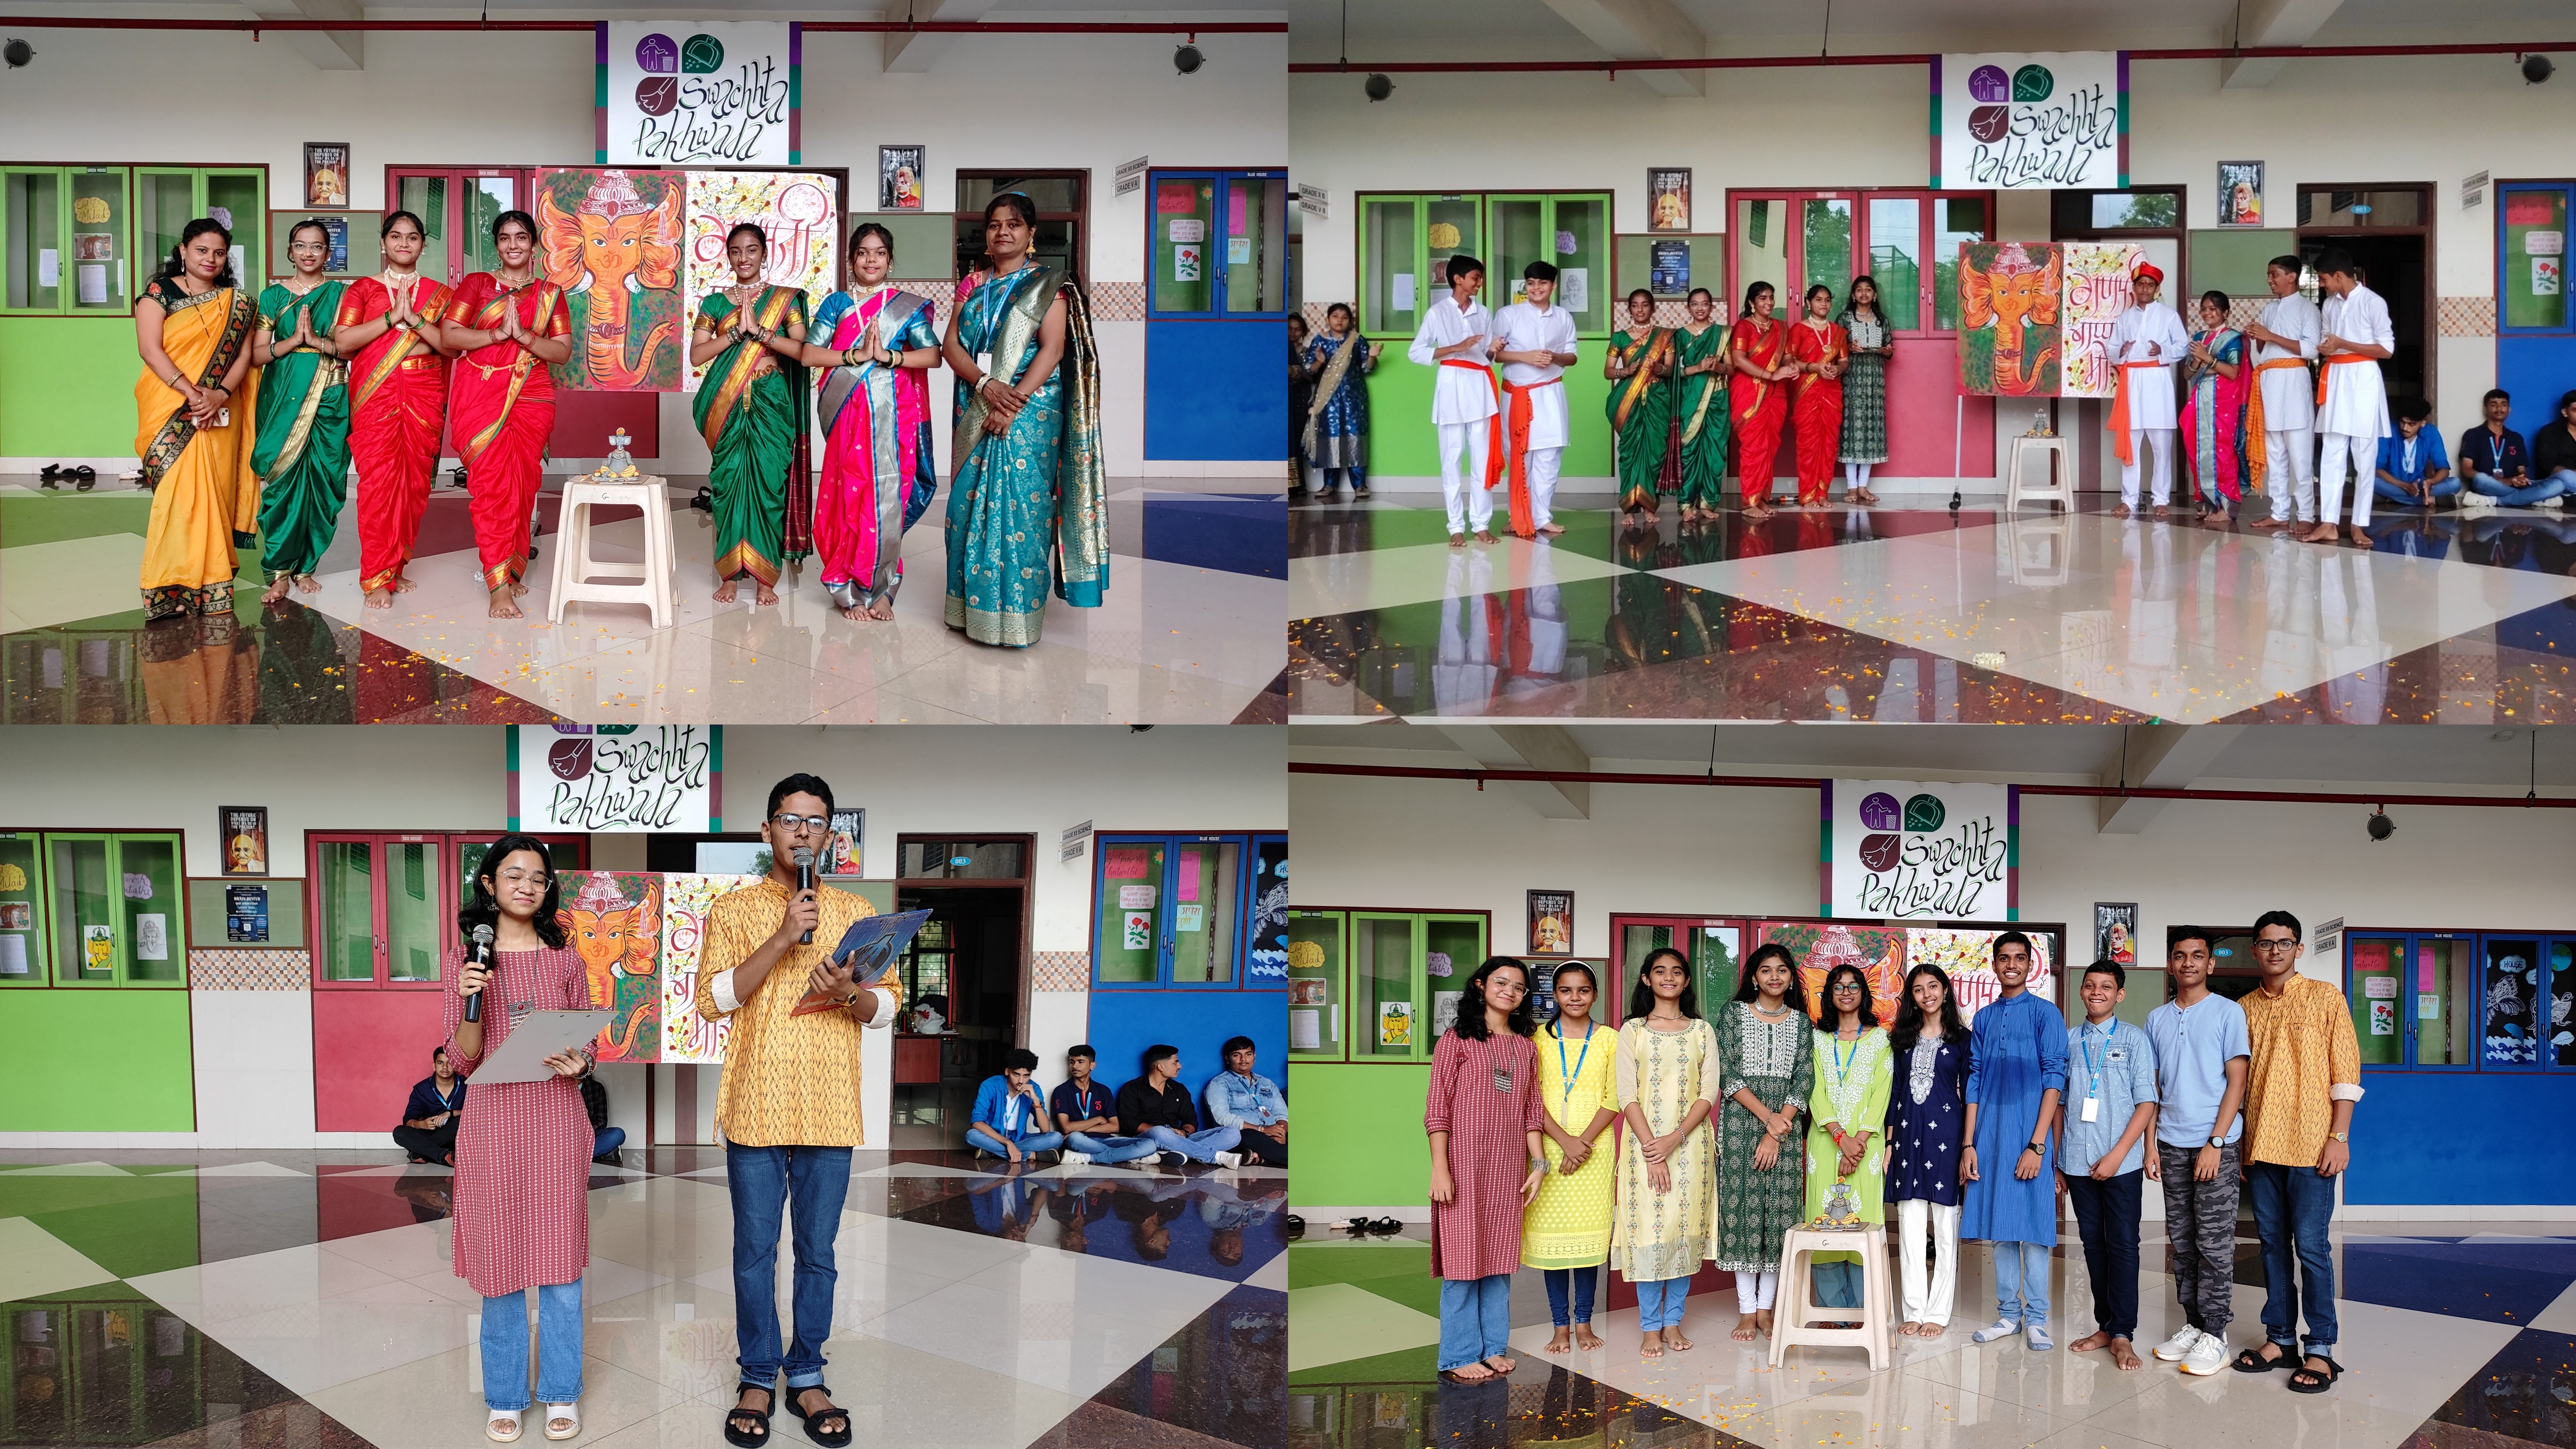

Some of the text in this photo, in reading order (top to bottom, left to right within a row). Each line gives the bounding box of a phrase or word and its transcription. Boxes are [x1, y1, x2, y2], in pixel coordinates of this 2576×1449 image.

[679, 56, 788, 124] Swachhta
[2009, 84, 2116, 149] Swachhta
[632, 109, 763, 163] Pakhwada
[1116, 168, 1127, 176] GRADE
[1133, 160, 1147, 170] SCIENCE
[1965, 136, 2091, 188] Pakhwada
[1117, 183, 1130, 192] GRADE
[1302, 188, 1317, 197] GRADE
[82, 207, 107, 221] Milad
[1301, 202, 1318, 212] GRADE
[594, 724, 709, 789] Swachhta
[546, 773, 683, 830] Pakhwada
[1063, 832, 1074, 841] GRADE
[1078, 825, 1091, 835] SCIENCE
[1063, 847, 1075, 858] GRADE
[1901, 816, 2006, 882] Swachhta
[1856, 865, 1983, 918] Pakhwada
[2315, 927, 2325, 935] GRADE
[2329, 921, 2343, 930] SCIENCE
[1289, 943, 1302, 953] Eid
[2316, 941, 2328, 951] GRADE
[1294, 951, 1321, 966] Milad
[1428, 953, 1448, 965] nesh
[2354, 959, 2380, 969] haturthi
[2504, 960, 2524, 970] HOUSE
[1095, 1101, 1102, 1111] 3
